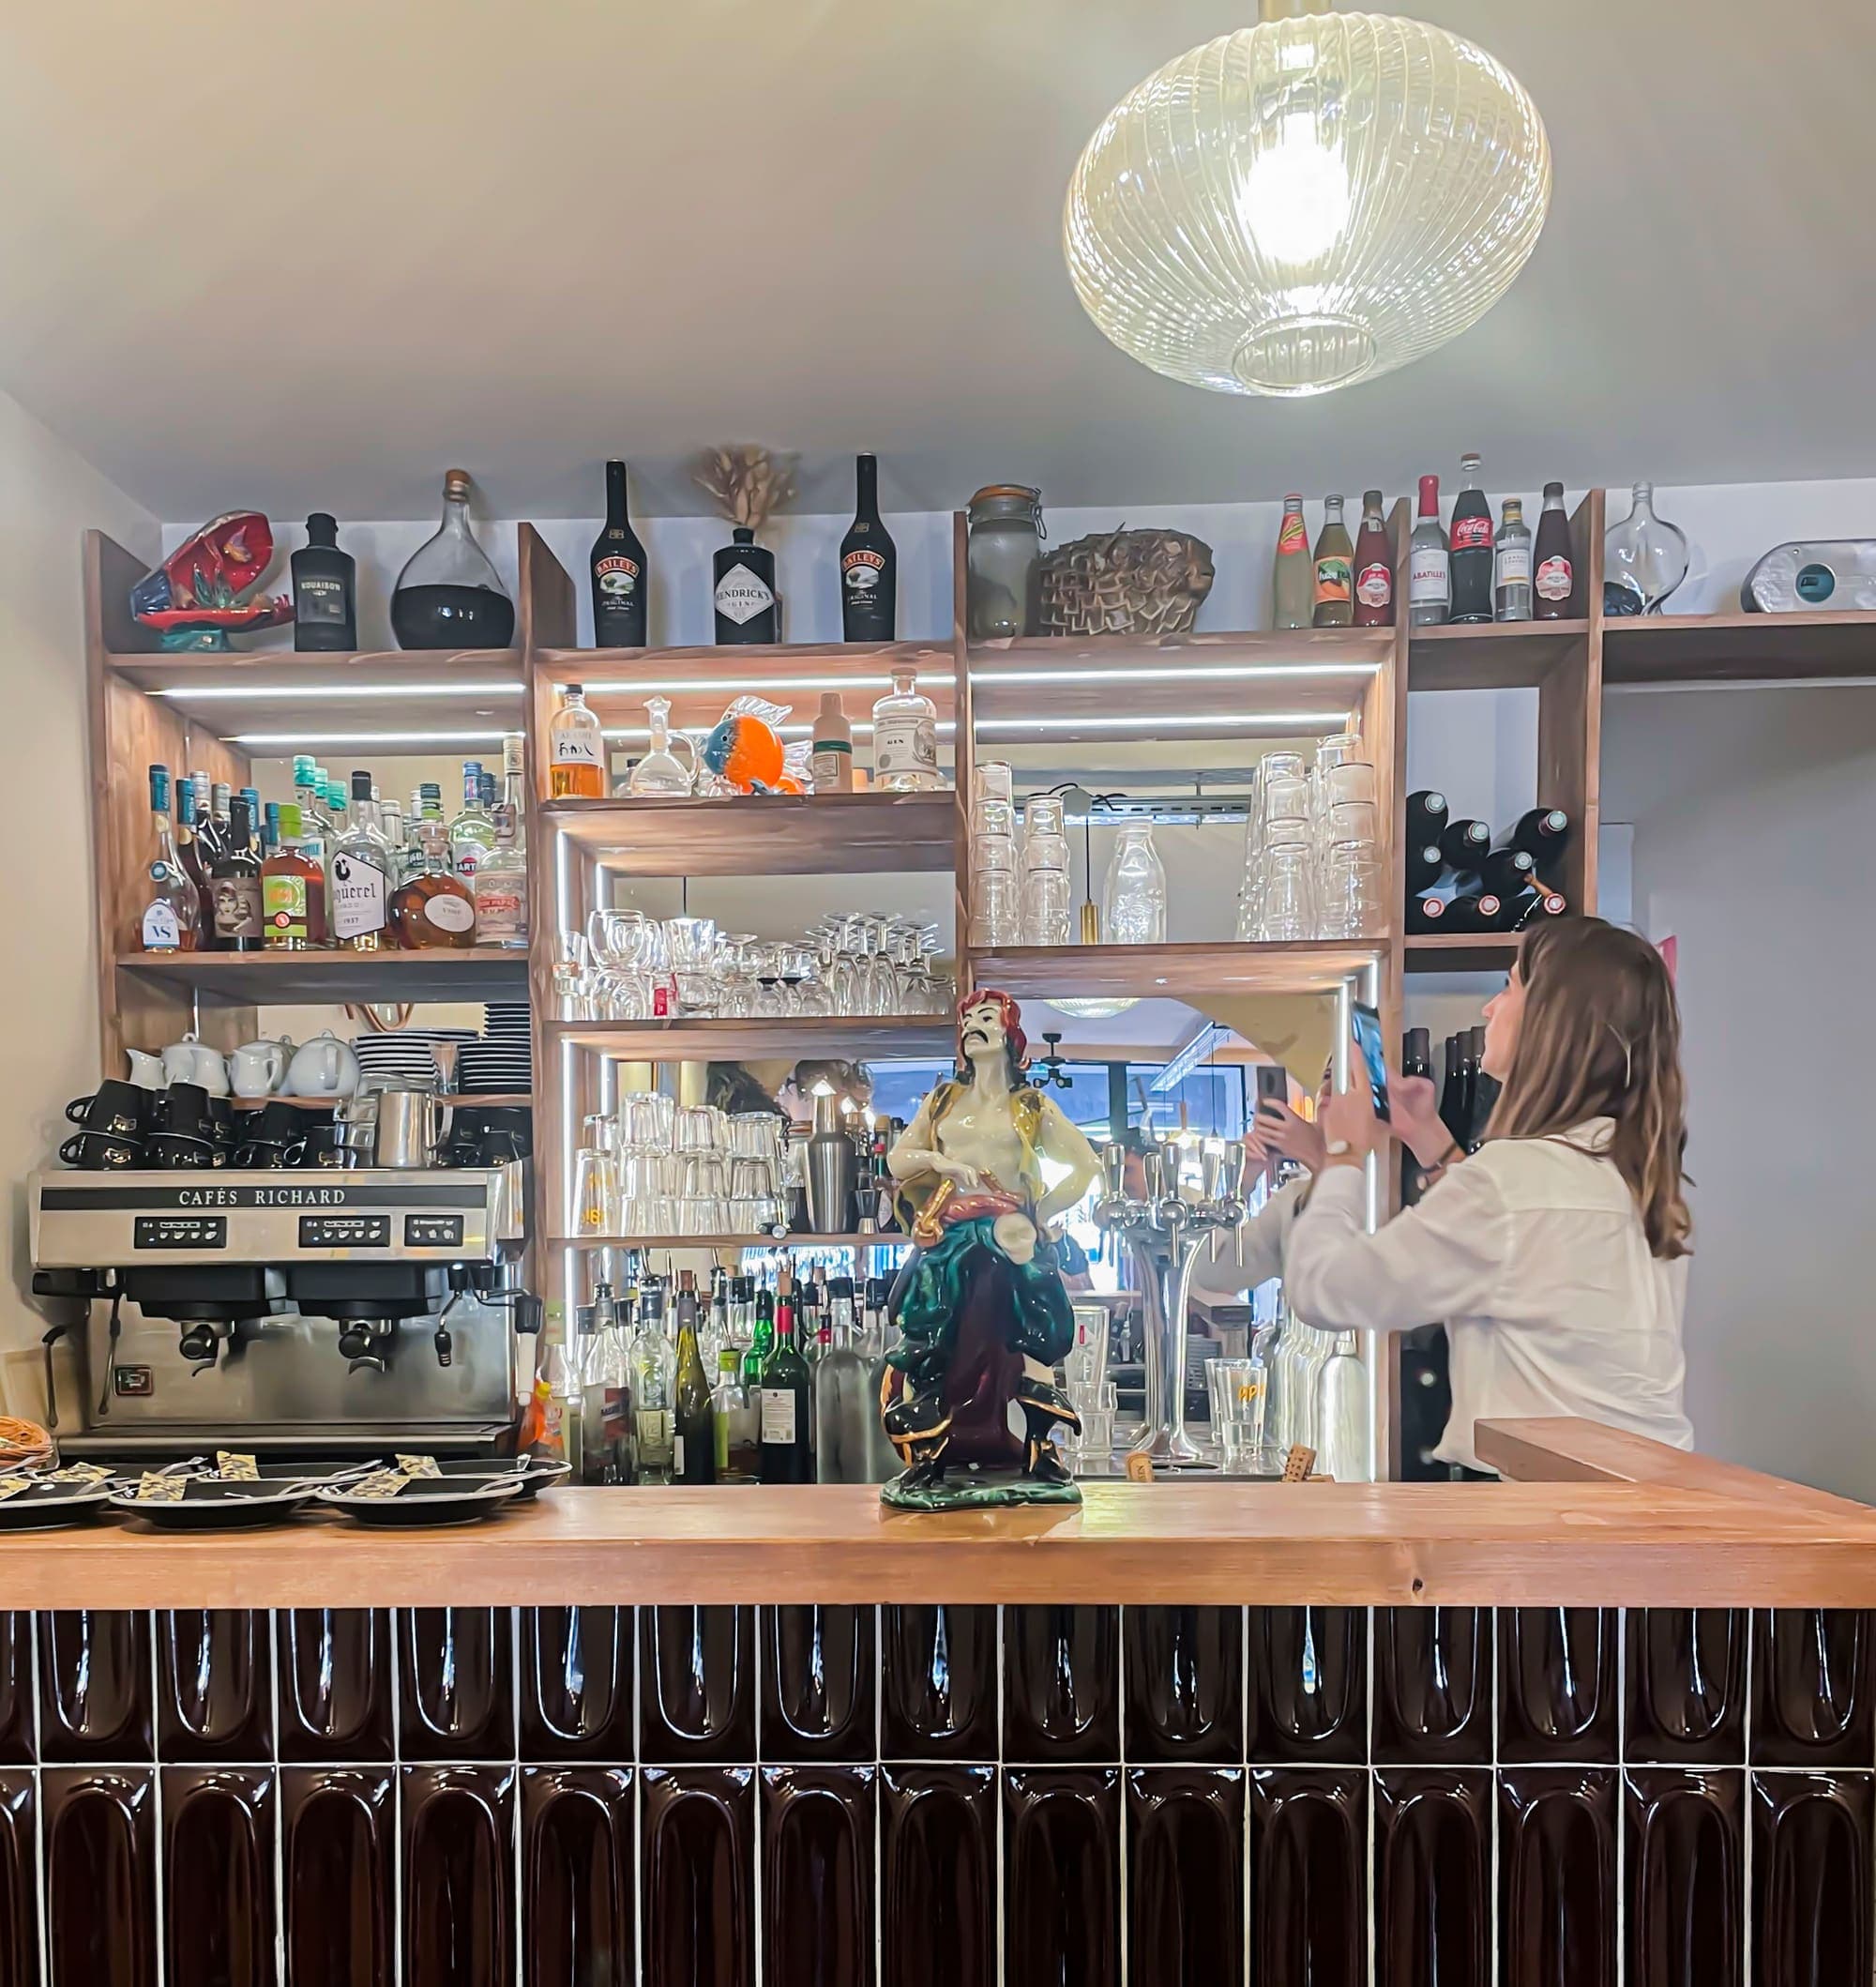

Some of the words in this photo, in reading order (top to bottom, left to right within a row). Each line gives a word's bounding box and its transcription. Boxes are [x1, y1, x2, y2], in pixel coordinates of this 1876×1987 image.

[597, 559, 637, 574] BAILEYS
[842, 553, 883, 569] BAILEYS
[178, 1188, 237, 1206] CAFÉS
[254, 1190, 345, 1205] RICHARD
